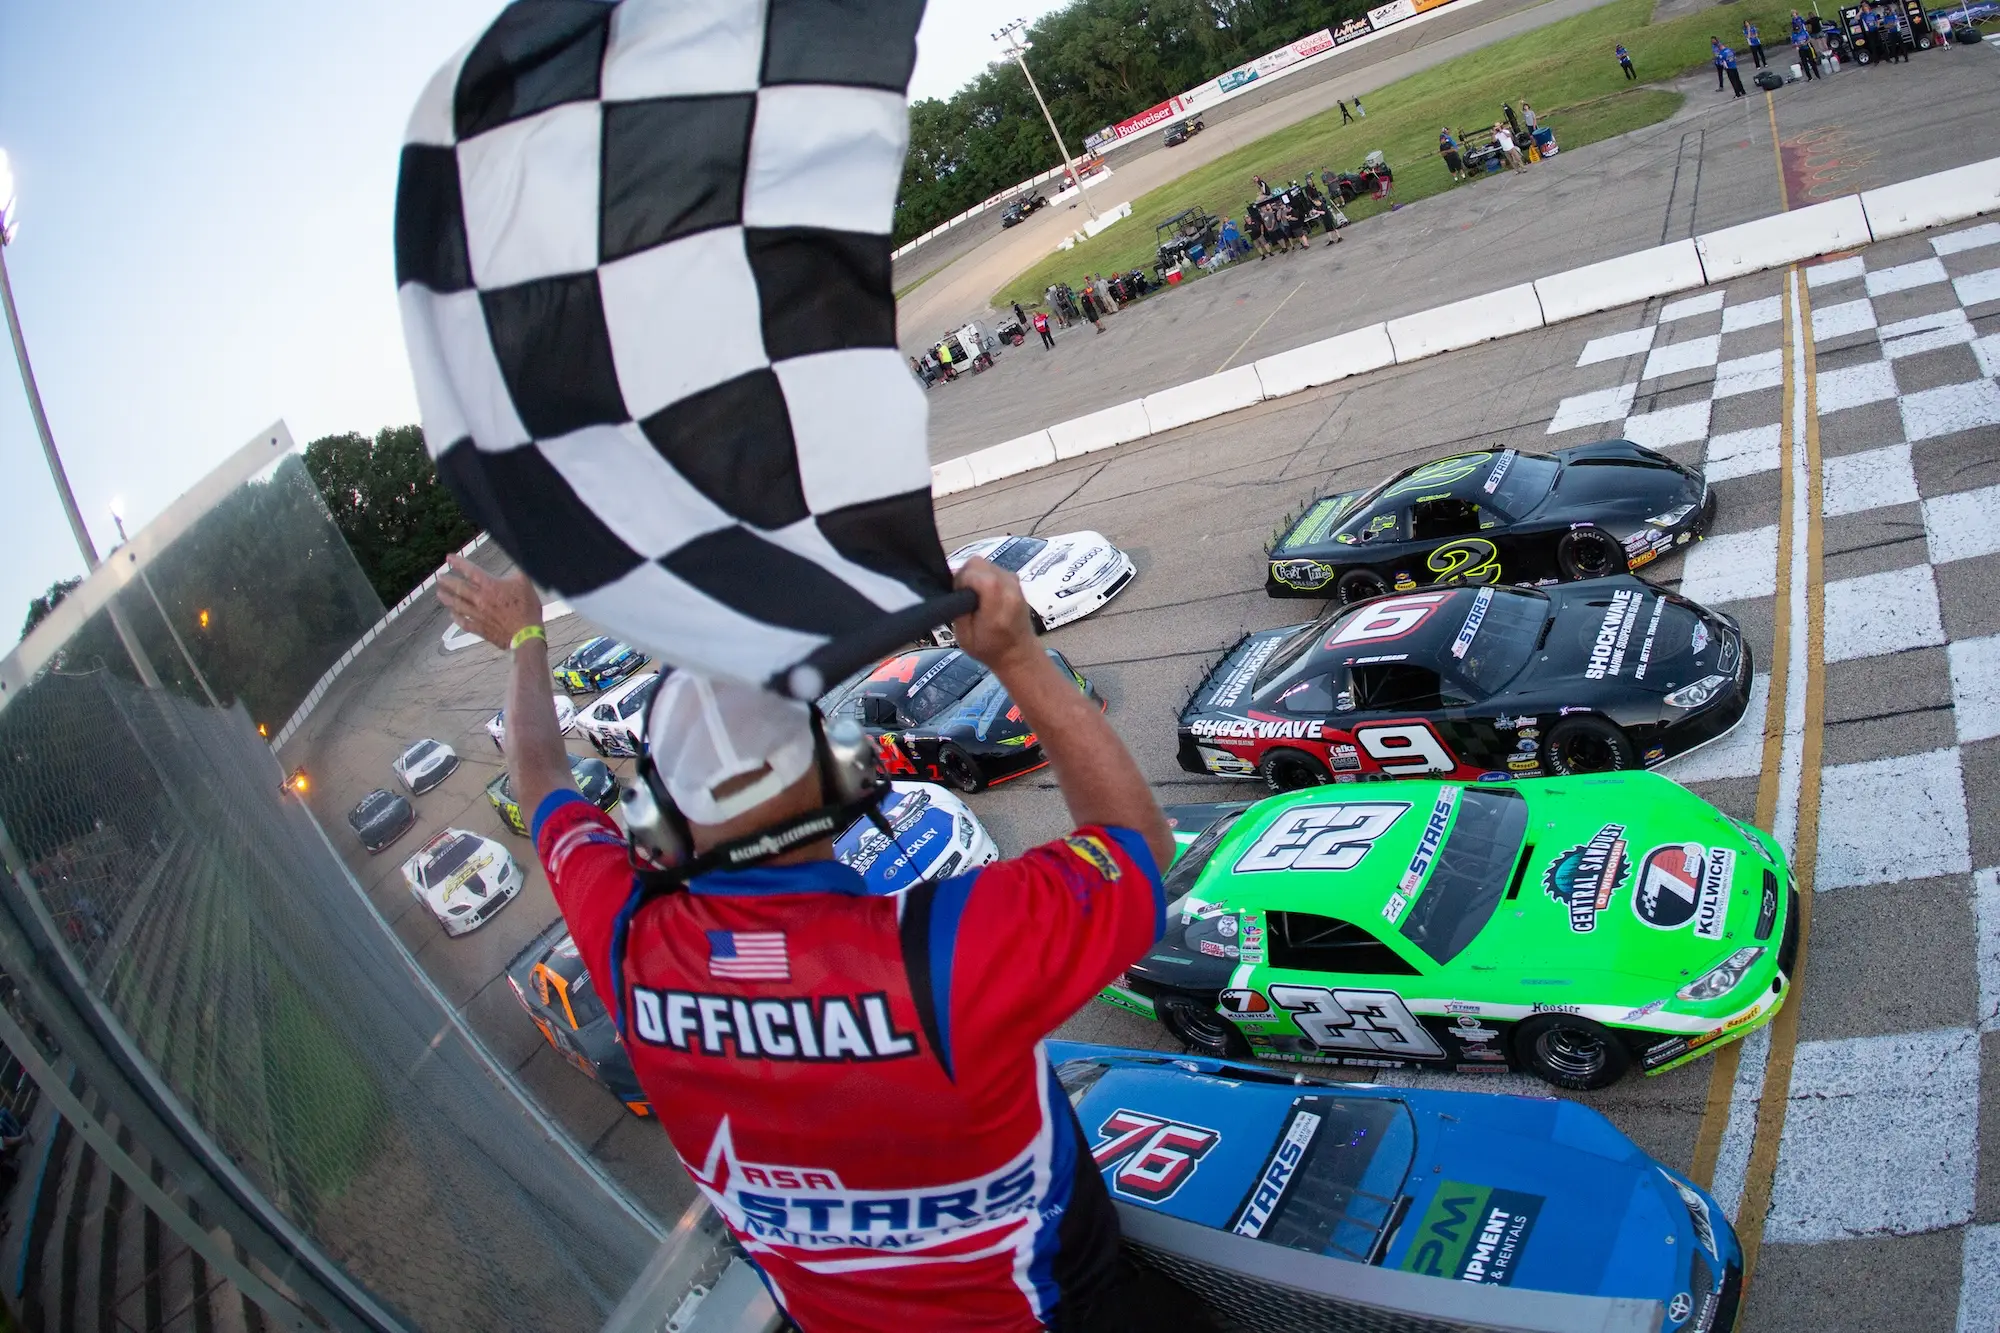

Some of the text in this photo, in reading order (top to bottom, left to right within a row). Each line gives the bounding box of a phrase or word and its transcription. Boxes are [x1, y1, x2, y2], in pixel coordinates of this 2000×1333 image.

[1117, 107, 1169, 138] Budweiser
[1489, 454, 1512, 485] STARS
[1459, 595, 1488, 644] STARS
[1584, 589, 1632, 680] SHOCKWAVE
[915, 658, 951, 687] STARS
[1220, 636, 1282, 708] SHOCKWAVE
[1607, 647, 1625, 676] MARINE
[1634, 662, 1647, 680] FEEL
[1190, 719, 1326, 739] SHOCKWAVE
[1357, 724, 1455, 775] 9
[894, 827, 938, 868] RACKLEY
[1409, 800, 1452, 877] STARS
[1572, 823, 1624, 931] CENTRAL SANDUST
[1597, 841, 1625, 906] OF WISCONSIN
[1698, 849, 1726, 935] KULWICKI
[634, 988, 914, 1060] OFFICIAL
[1267, 983, 1448, 1060] 23
[1531, 1002, 1581, 1014] Hoosier
[1727, 1007, 1758, 1028] Bassett
[1256, 1052, 1405, 1069] VAN DER GEEST
[1091, 1106, 1221, 1204] 76
[737, 1153, 1035, 1232] STARS
[1236, 1138, 1303, 1237] TARS
[744, 1214, 924, 1249] NATIONAL
[1496, 1215, 1527, 1268] RENTALS
